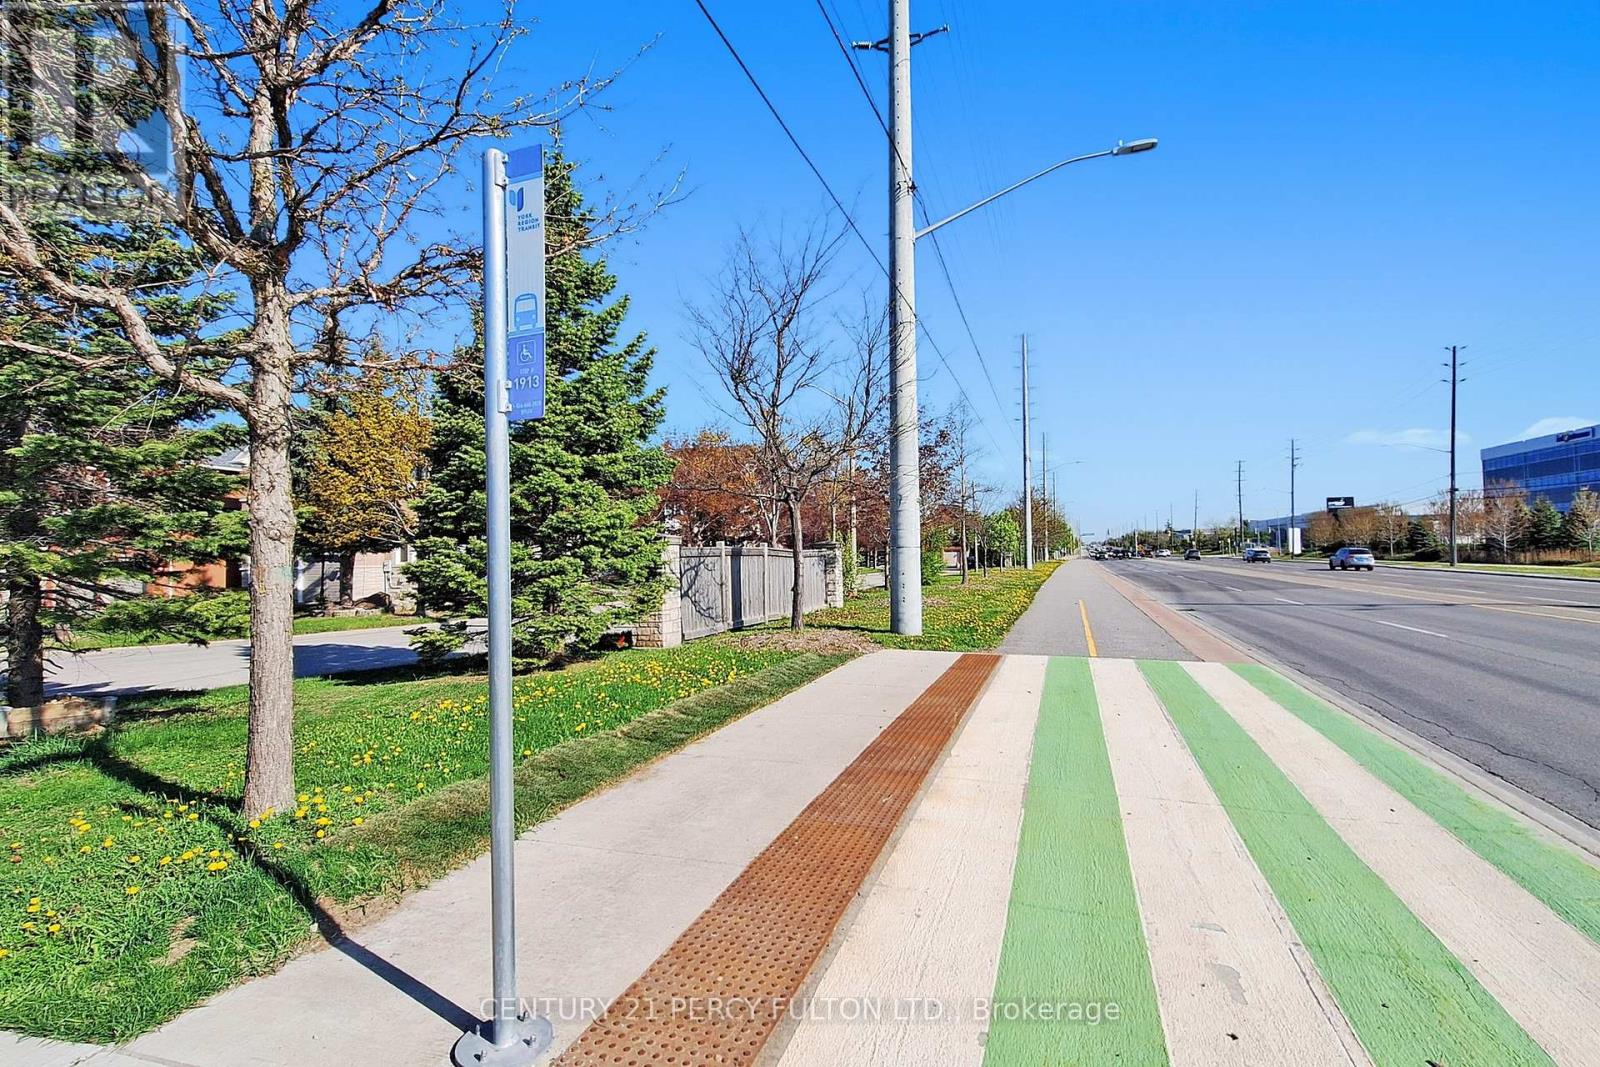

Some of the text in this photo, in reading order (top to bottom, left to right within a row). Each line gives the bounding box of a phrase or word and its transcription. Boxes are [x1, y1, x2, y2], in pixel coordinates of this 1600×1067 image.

[518, 217, 539, 226] REGION
[518, 223, 540, 232] TRANSIT
[513, 375, 540, 390] 1913
